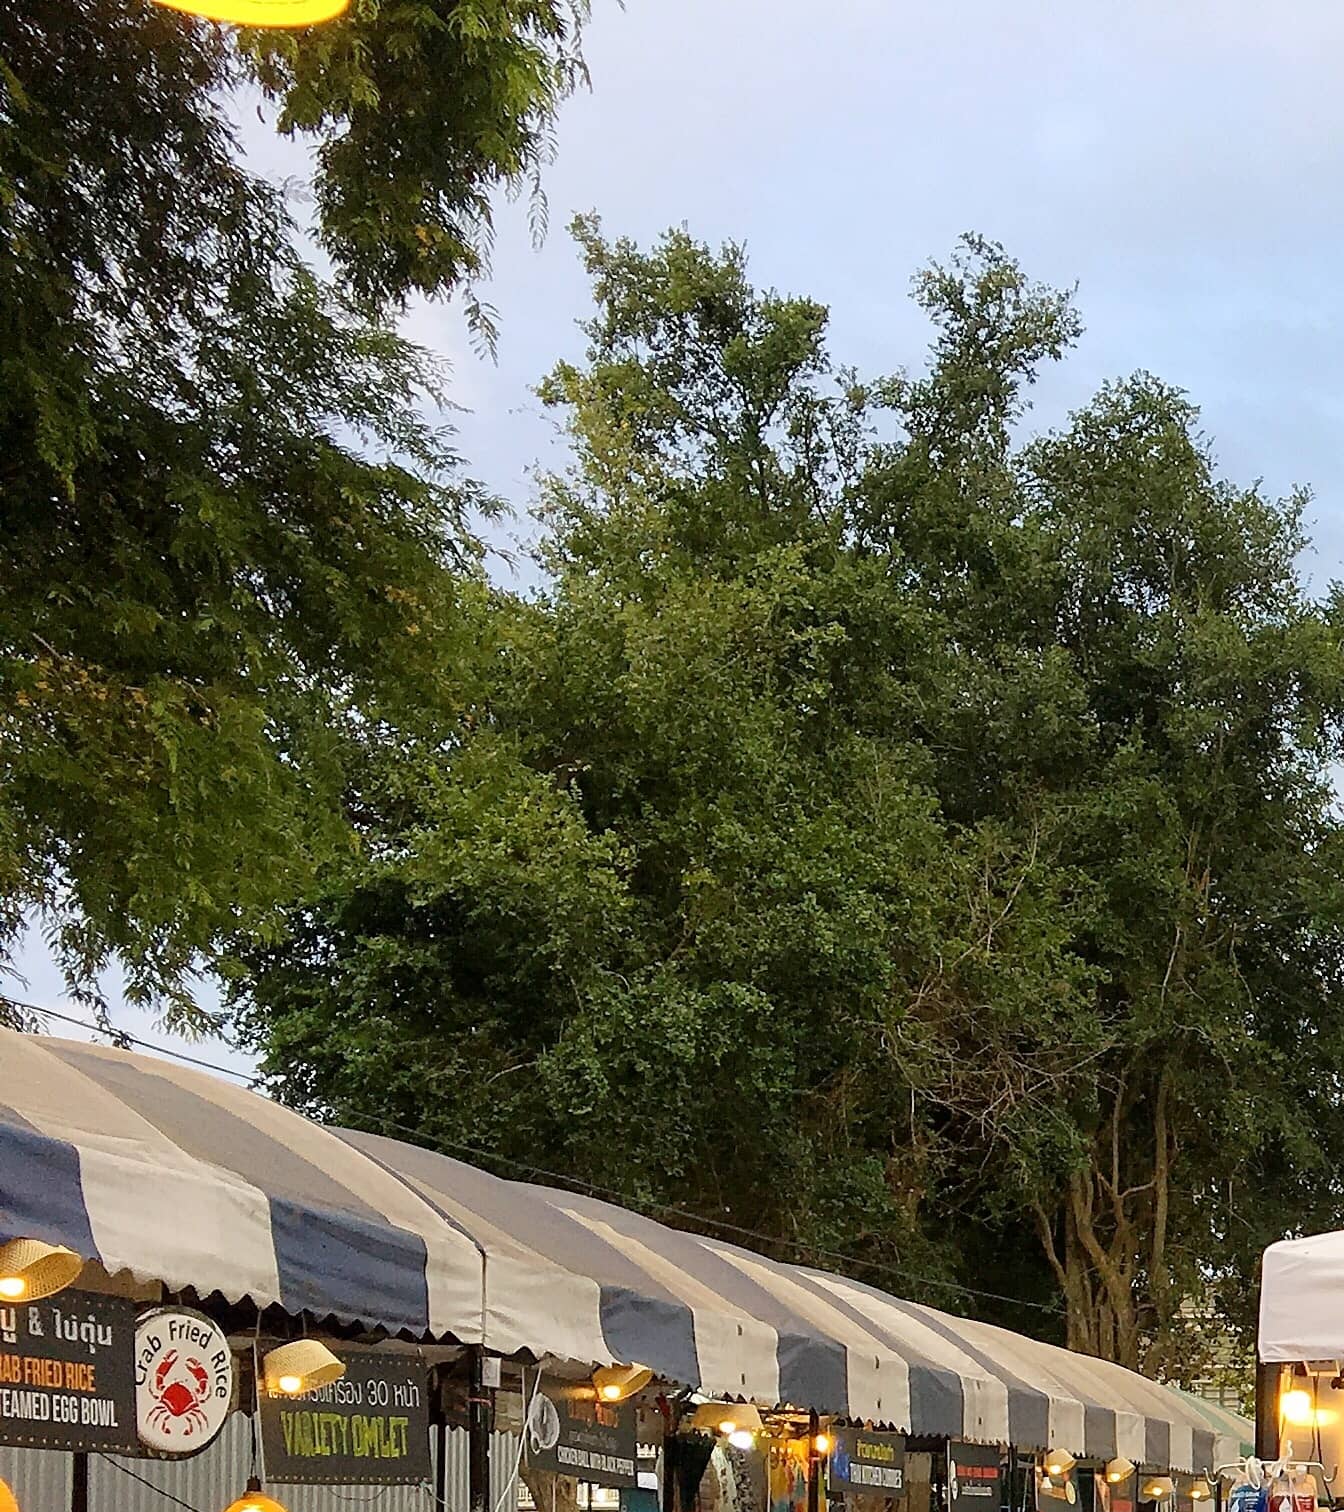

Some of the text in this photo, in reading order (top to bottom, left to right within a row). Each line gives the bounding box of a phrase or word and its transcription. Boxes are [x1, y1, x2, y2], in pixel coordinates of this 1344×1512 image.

[28, 1306, 44, 1337] &
[0, 1354, 96, 1392] AB FRIED RICE
[168, 1320, 212, 1350] Fried
[210, 1350, 228, 1398] Rice
[367, 1380, 389, 1406] 30
[52, 1394, 79, 1424] EGG
[81, 1397, 118, 1427] BOWL
